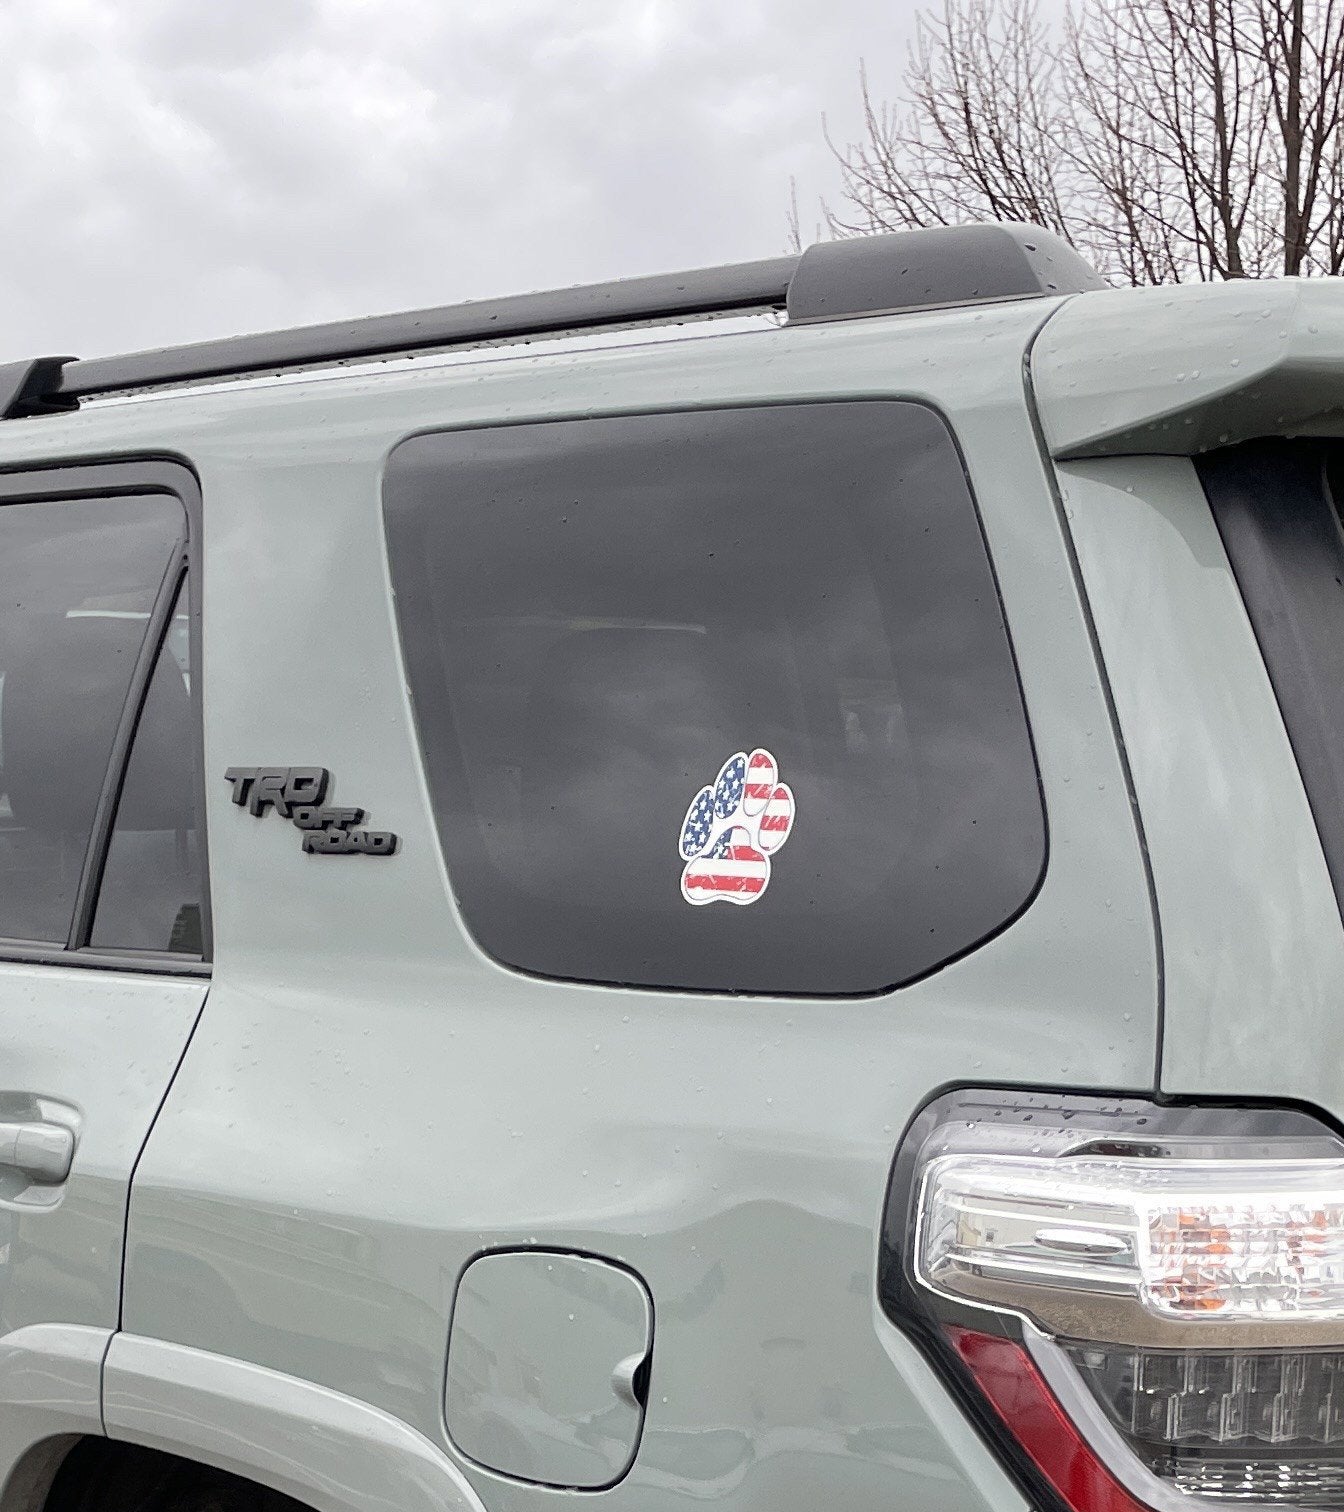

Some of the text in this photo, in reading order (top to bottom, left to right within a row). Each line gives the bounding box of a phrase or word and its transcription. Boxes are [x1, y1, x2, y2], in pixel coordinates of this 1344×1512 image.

[224, 767, 330, 818] TRD
[292, 806, 365, 830] OFF
[302, 831, 398, 855] ROAD
